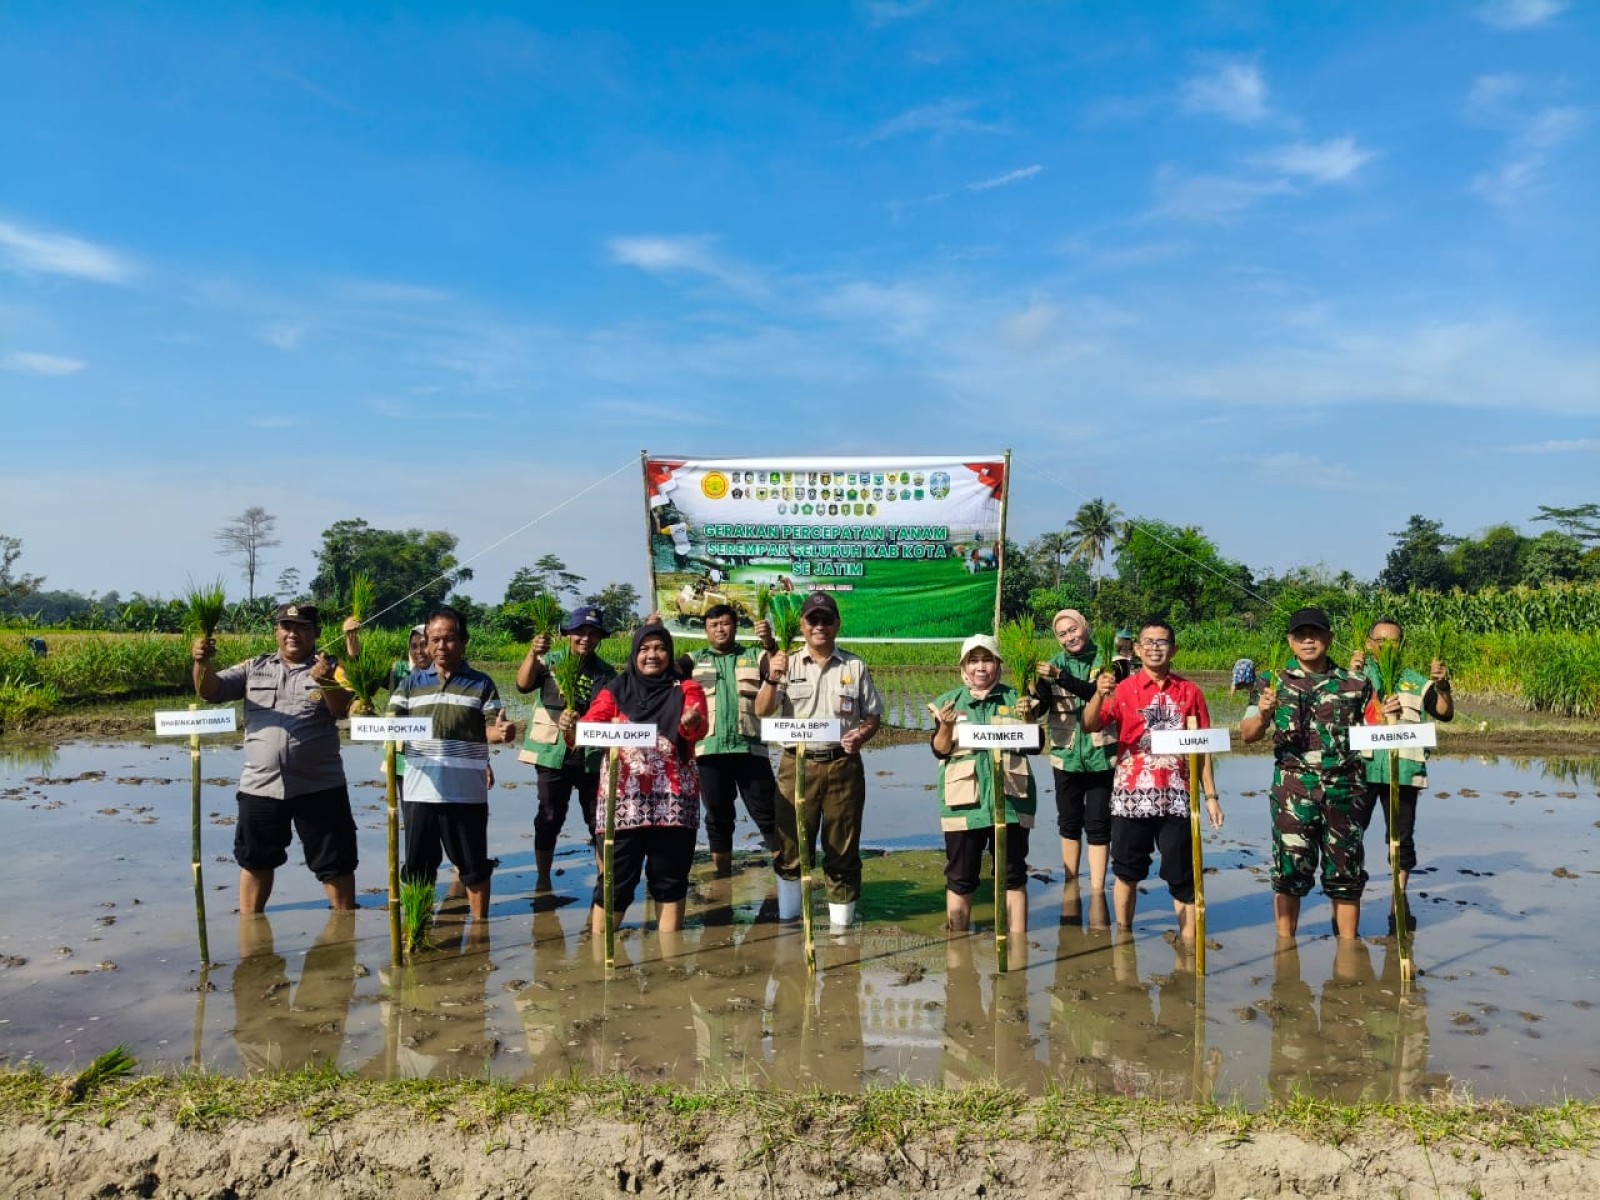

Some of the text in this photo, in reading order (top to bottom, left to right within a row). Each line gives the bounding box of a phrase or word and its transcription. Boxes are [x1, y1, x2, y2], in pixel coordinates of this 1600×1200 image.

[704, 524, 948, 541] GERAKAN PERCEPATAN TANAM
[707, 541, 947, 559] SEREMPAK SELURUH KAB KOTA
[792, 561, 864, 576] SE JATIM
[357, 725, 427, 733] KETUA POKTAN
[774, 722, 830, 730] KEPALA BBPP
[583, 730, 651, 740] KEPALA DKPP
[790, 731, 813, 739] BATU
[973, 731, 1025, 741] KATIMKER
[1371, 732, 1417, 742] BABINSA
[1179, 737, 1210, 746] LURAH
